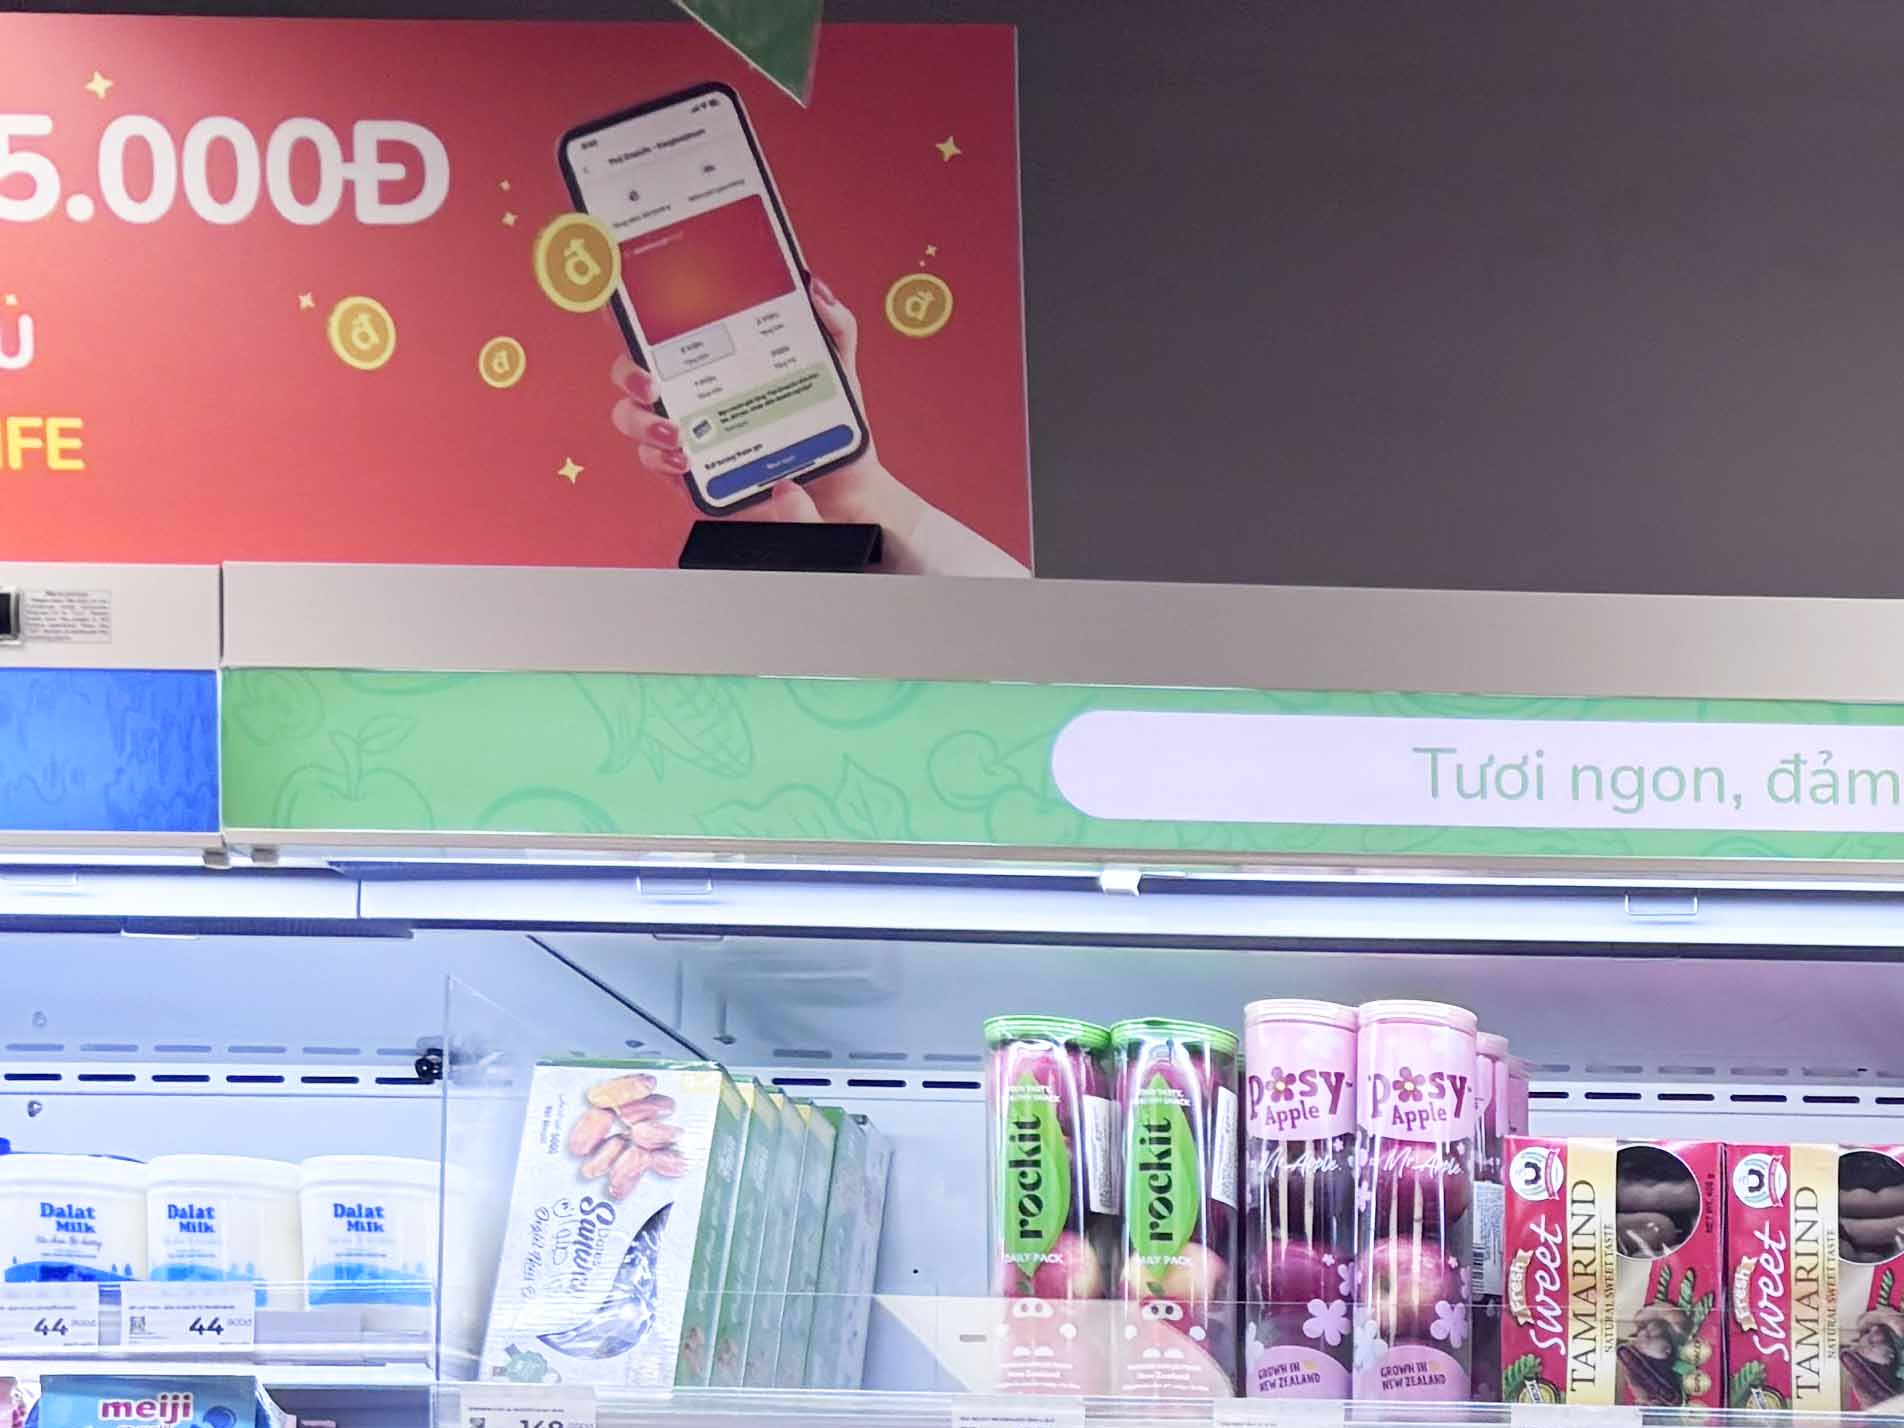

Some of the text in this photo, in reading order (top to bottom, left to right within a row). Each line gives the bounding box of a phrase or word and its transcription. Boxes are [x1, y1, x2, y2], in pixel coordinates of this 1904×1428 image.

[1412, 746, 1546, 802] Tươi
[1570, 755, 1743, 815] ngon,
[1767, 750, 1902, 808] đảm
[1265, 1100, 1320, 1131] Apple
[1392, 1102, 1447, 1132] Apple
[1009, 1114, 1043, 1238] rockit
[1139, 1117, 1173, 1241] rockit
[40, 1202, 96, 1220] Dalat
[168, 1204, 215, 1219] Dalat
[333, 1203, 384, 1219] Dalat
[1571, 1179, 1596, 1392] TAMARIND
[1794, 1185, 1820, 1399] TAMARIND
[33, 1318, 68, 1336] 44
[189, 1317, 223, 1335] 44
[100, 1393, 193, 1424] meiji
